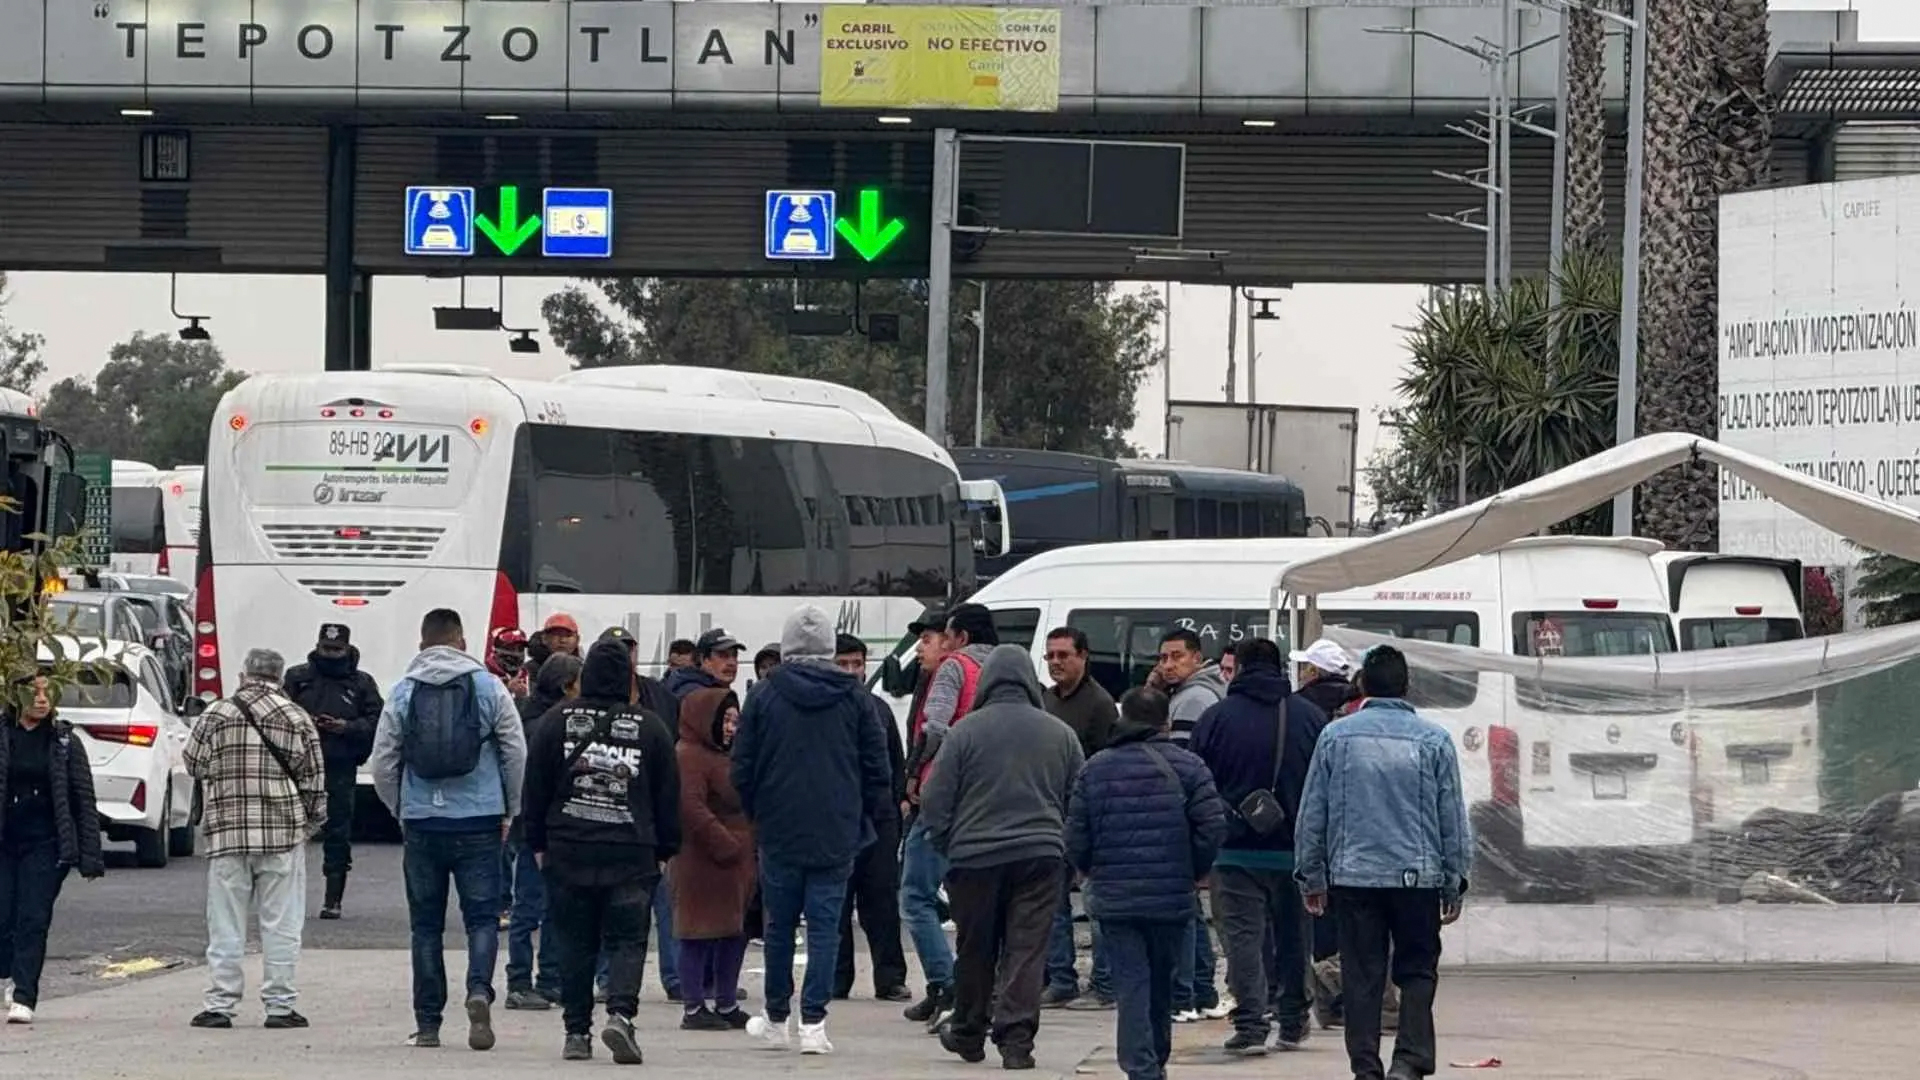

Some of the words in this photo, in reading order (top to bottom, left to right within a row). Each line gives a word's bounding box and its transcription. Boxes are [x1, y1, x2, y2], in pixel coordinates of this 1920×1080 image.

[841, 23, 895, 34] CARRIL
[1005, 23, 1030, 33] CON
[1033, 23, 1056, 34] TAG
[826, 39, 909, 50] EXCLUSIVO
[927, 37, 954, 50] NO
[959, 38, 1047, 53] EFECTIVO
[1843, 200, 1881, 219] CAPUFE
[1800, 317, 1810, 354] Y
[1811, 300, 1917, 353] MODERNIZACIÓN
[1719, 394, 1753, 430] PLAZA
[1756, 392, 1771, 429] DE
[1772, 388, 1815, 427] COBRO
[1816, 386, 1900, 425] TEPOTZOTLAN
[329, 430, 370, 456] 89-HB
[1818, 449, 1866, 494] MÉXICO
